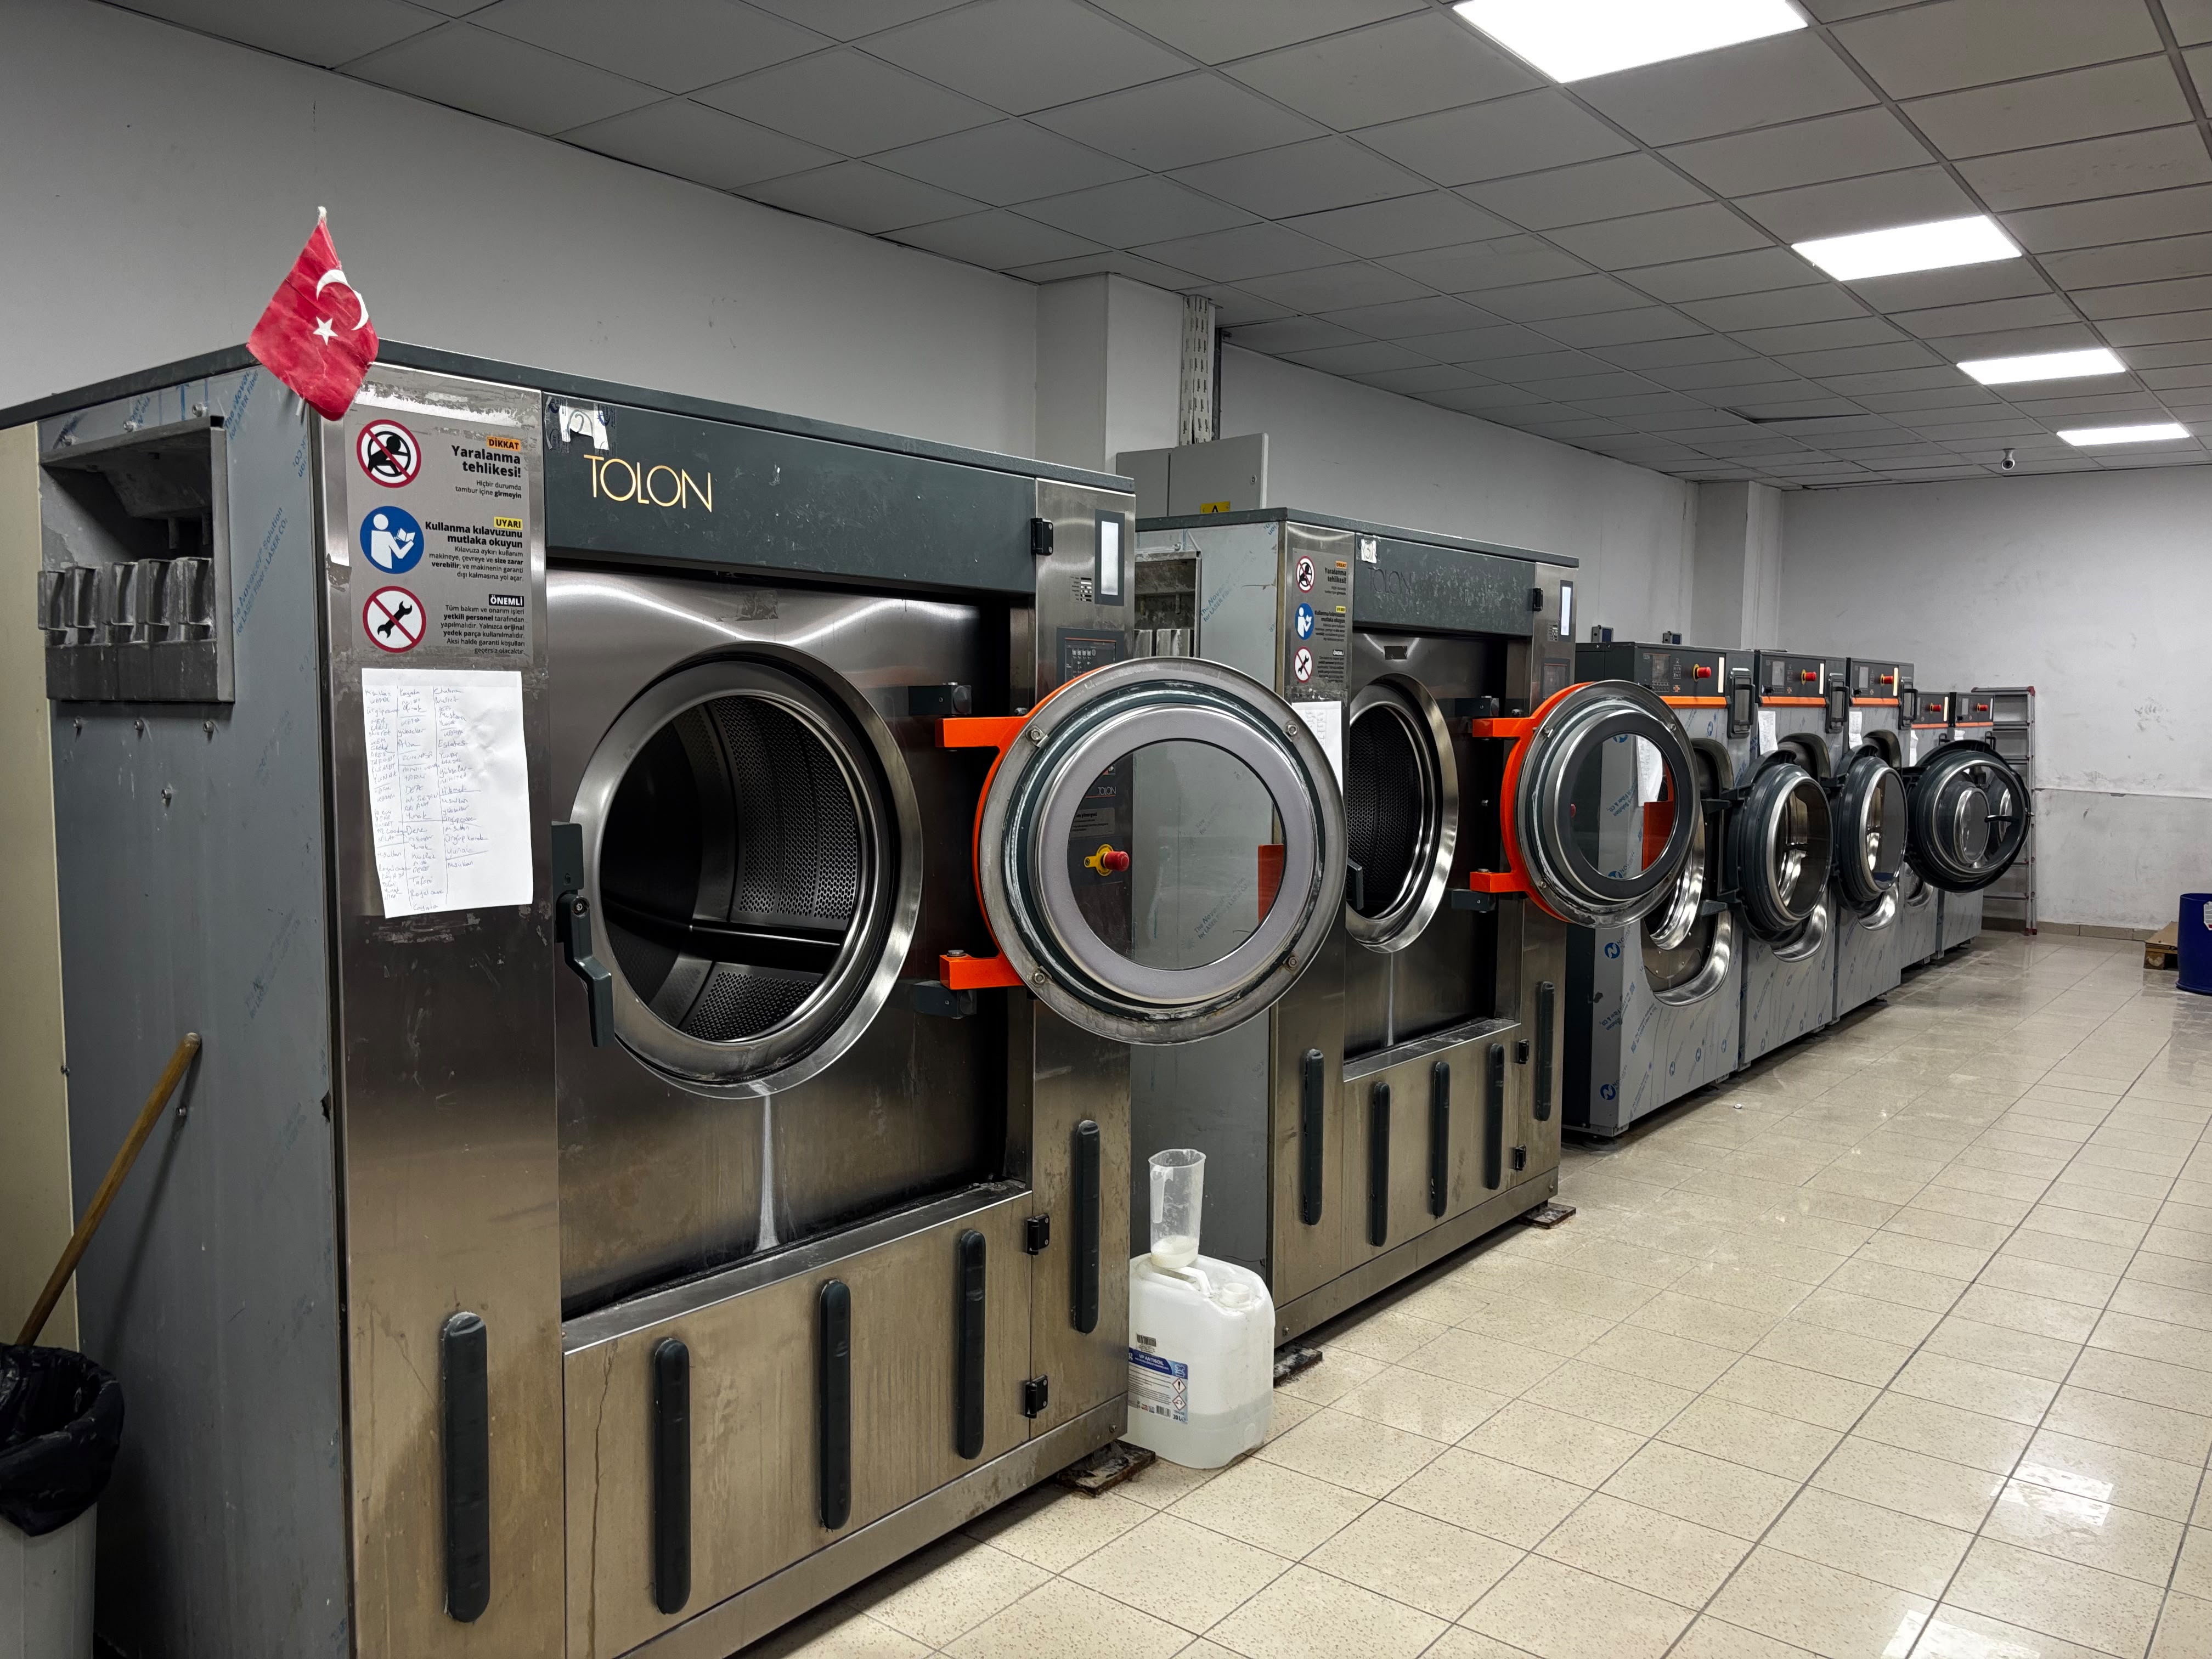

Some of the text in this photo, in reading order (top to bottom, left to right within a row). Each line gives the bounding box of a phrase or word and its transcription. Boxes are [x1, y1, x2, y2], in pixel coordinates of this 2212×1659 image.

[489, 438, 519, 450] DİKKAT
[452, 445, 521, 464] Yaralanma
[462, 461, 521, 478] tehlikesi!
[476, 479, 521, 490] Hiçbir durumda
[583, 454, 712, 513] TOLON
[455, 486, 478, 494] tambur
[494, 490, 522, 500] girmeyin
[496, 518, 521, 528] UYARI
[425, 521, 522, 538] Kullanma kılavuzunu
[448, 535, 523, 549] mutlaka okuyun
[429, 552, 461, 561] makineye,
[481, 548, 497, 556] aykırı
[498, 549, 523, 557] kullanım
[469, 572, 499, 580] kalmasına
[500, 573, 509, 582] yol
[490, 595, 523, 606] ÖNEMLİ
[1098, 786, 1116, 795] TOLON
